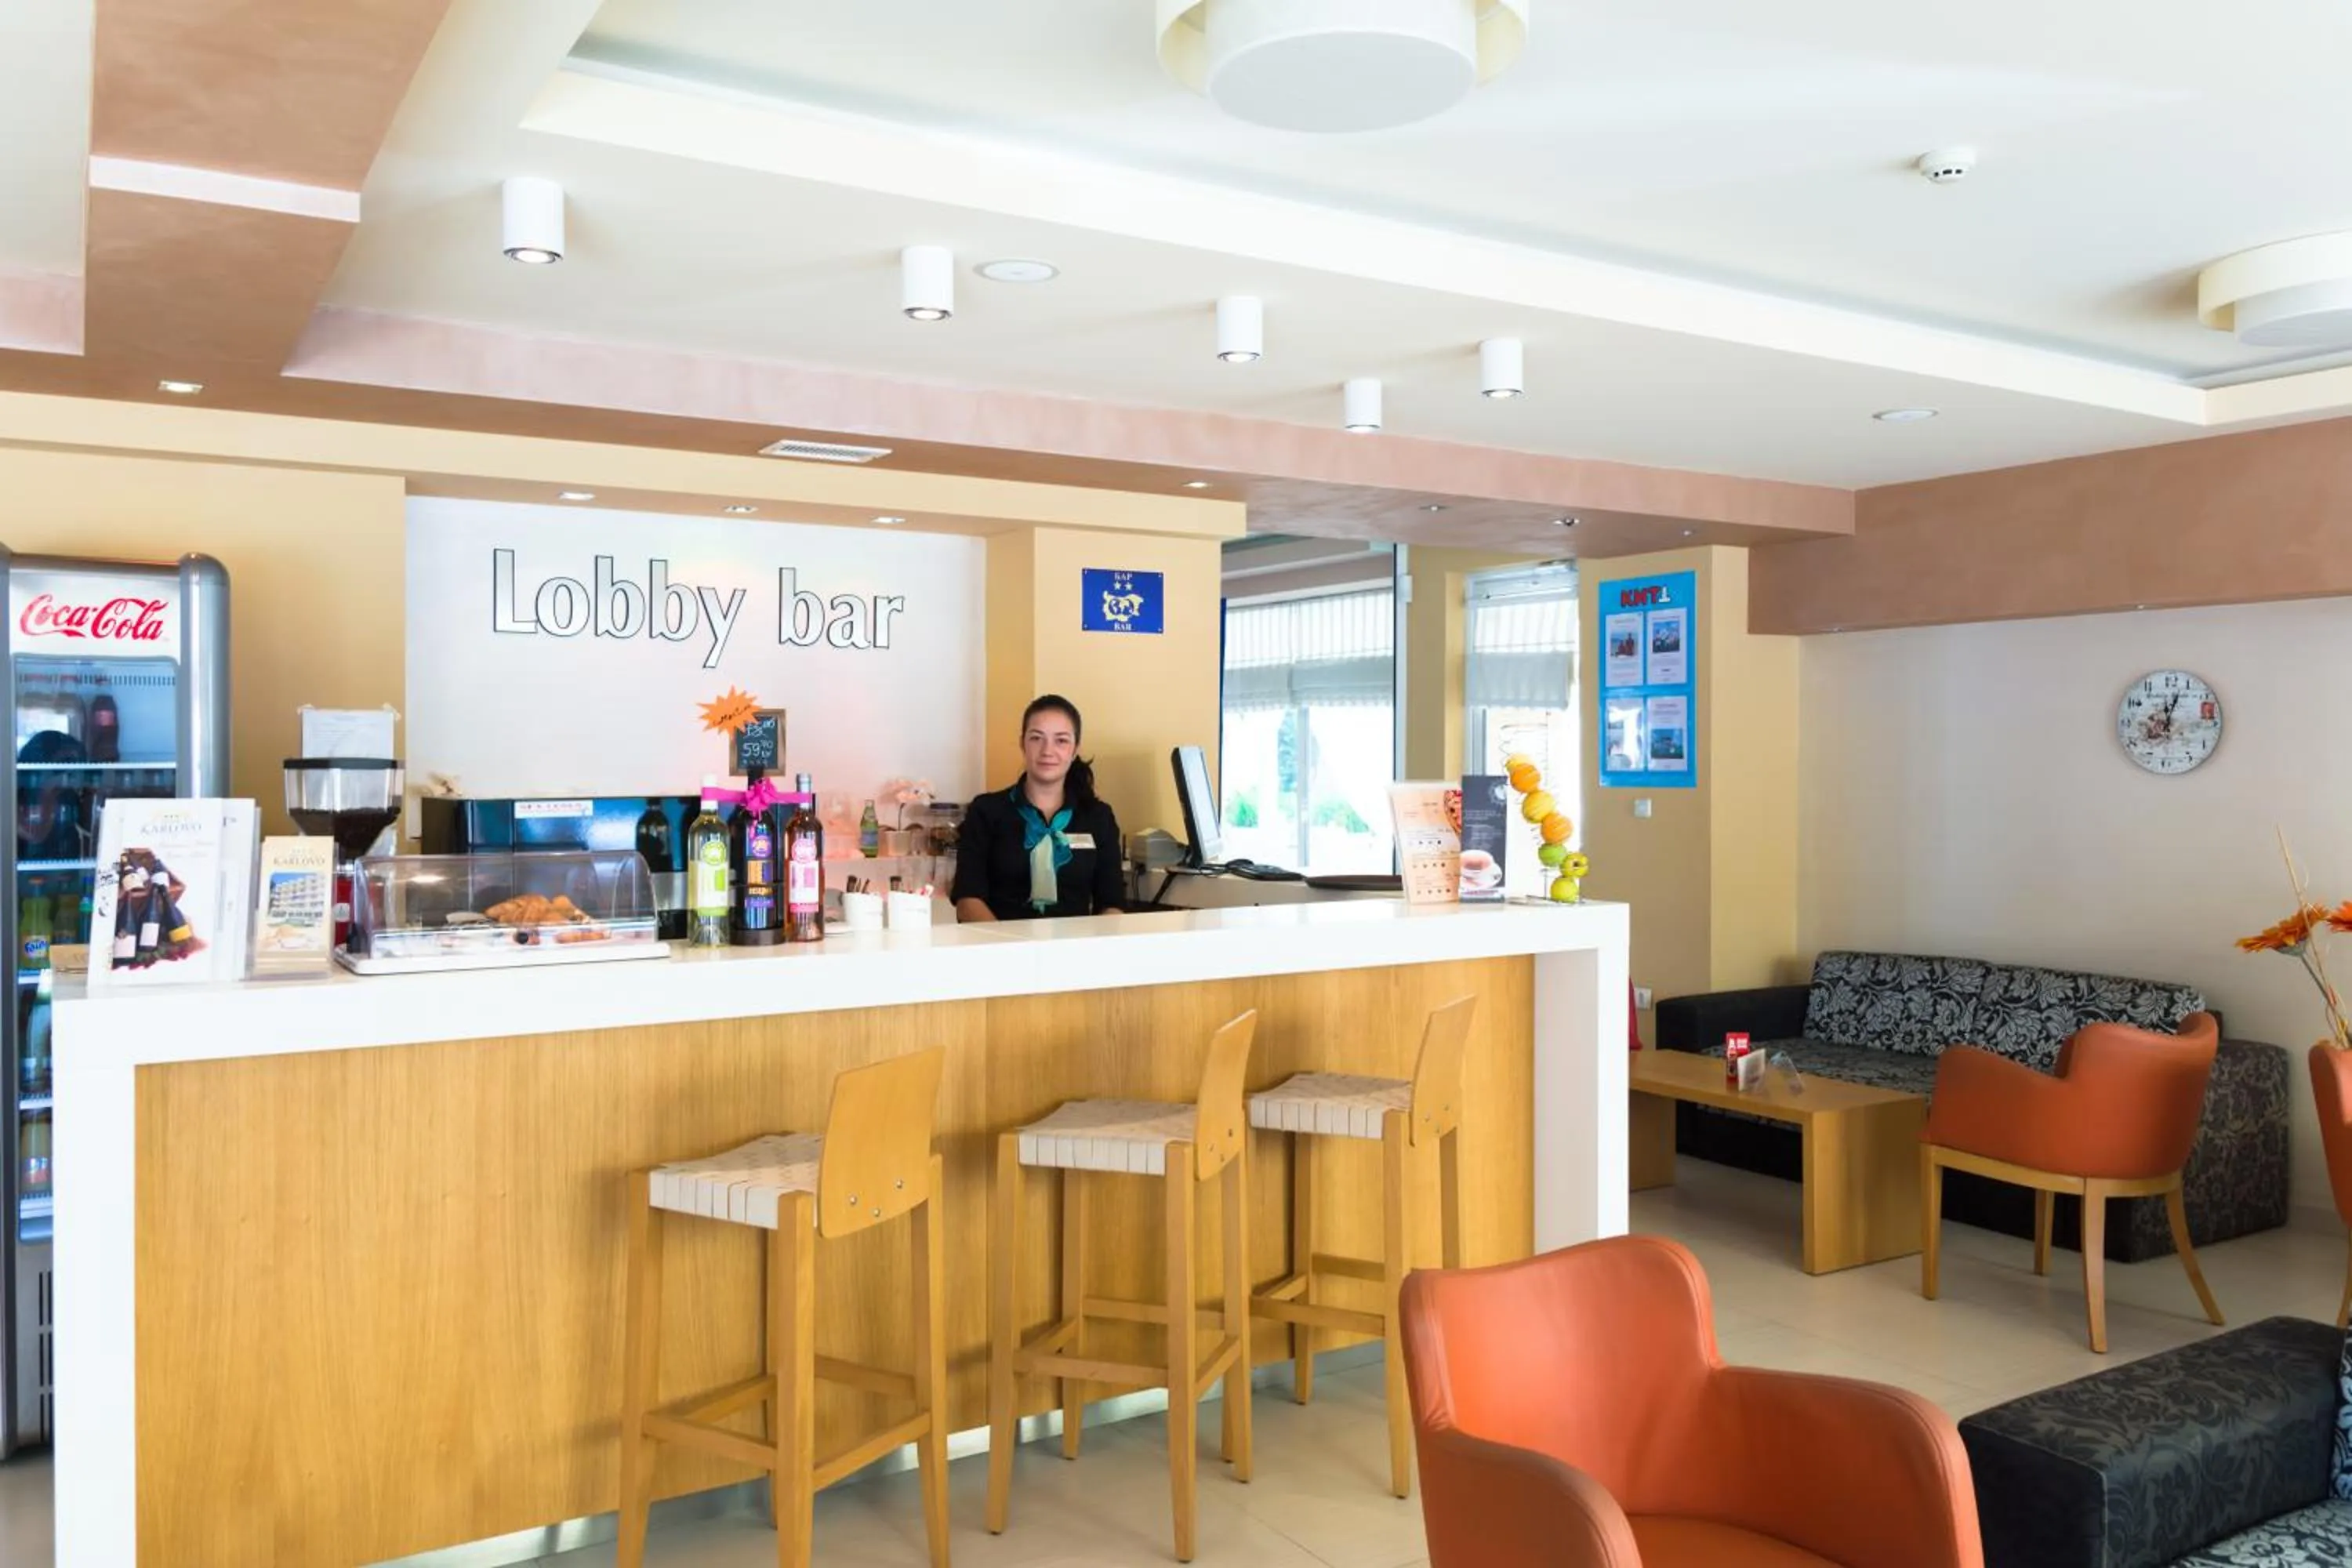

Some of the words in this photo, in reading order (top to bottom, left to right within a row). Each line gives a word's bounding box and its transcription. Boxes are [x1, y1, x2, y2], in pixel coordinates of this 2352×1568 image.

[20, 593, 169, 641] Coca-Cola
[493, 548, 746, 669] Lobby
[779, 566, 906, 649] bar
[140, 822, 202, 836] KARLOVO
[274, 856, 325, 866] KARLOVO
